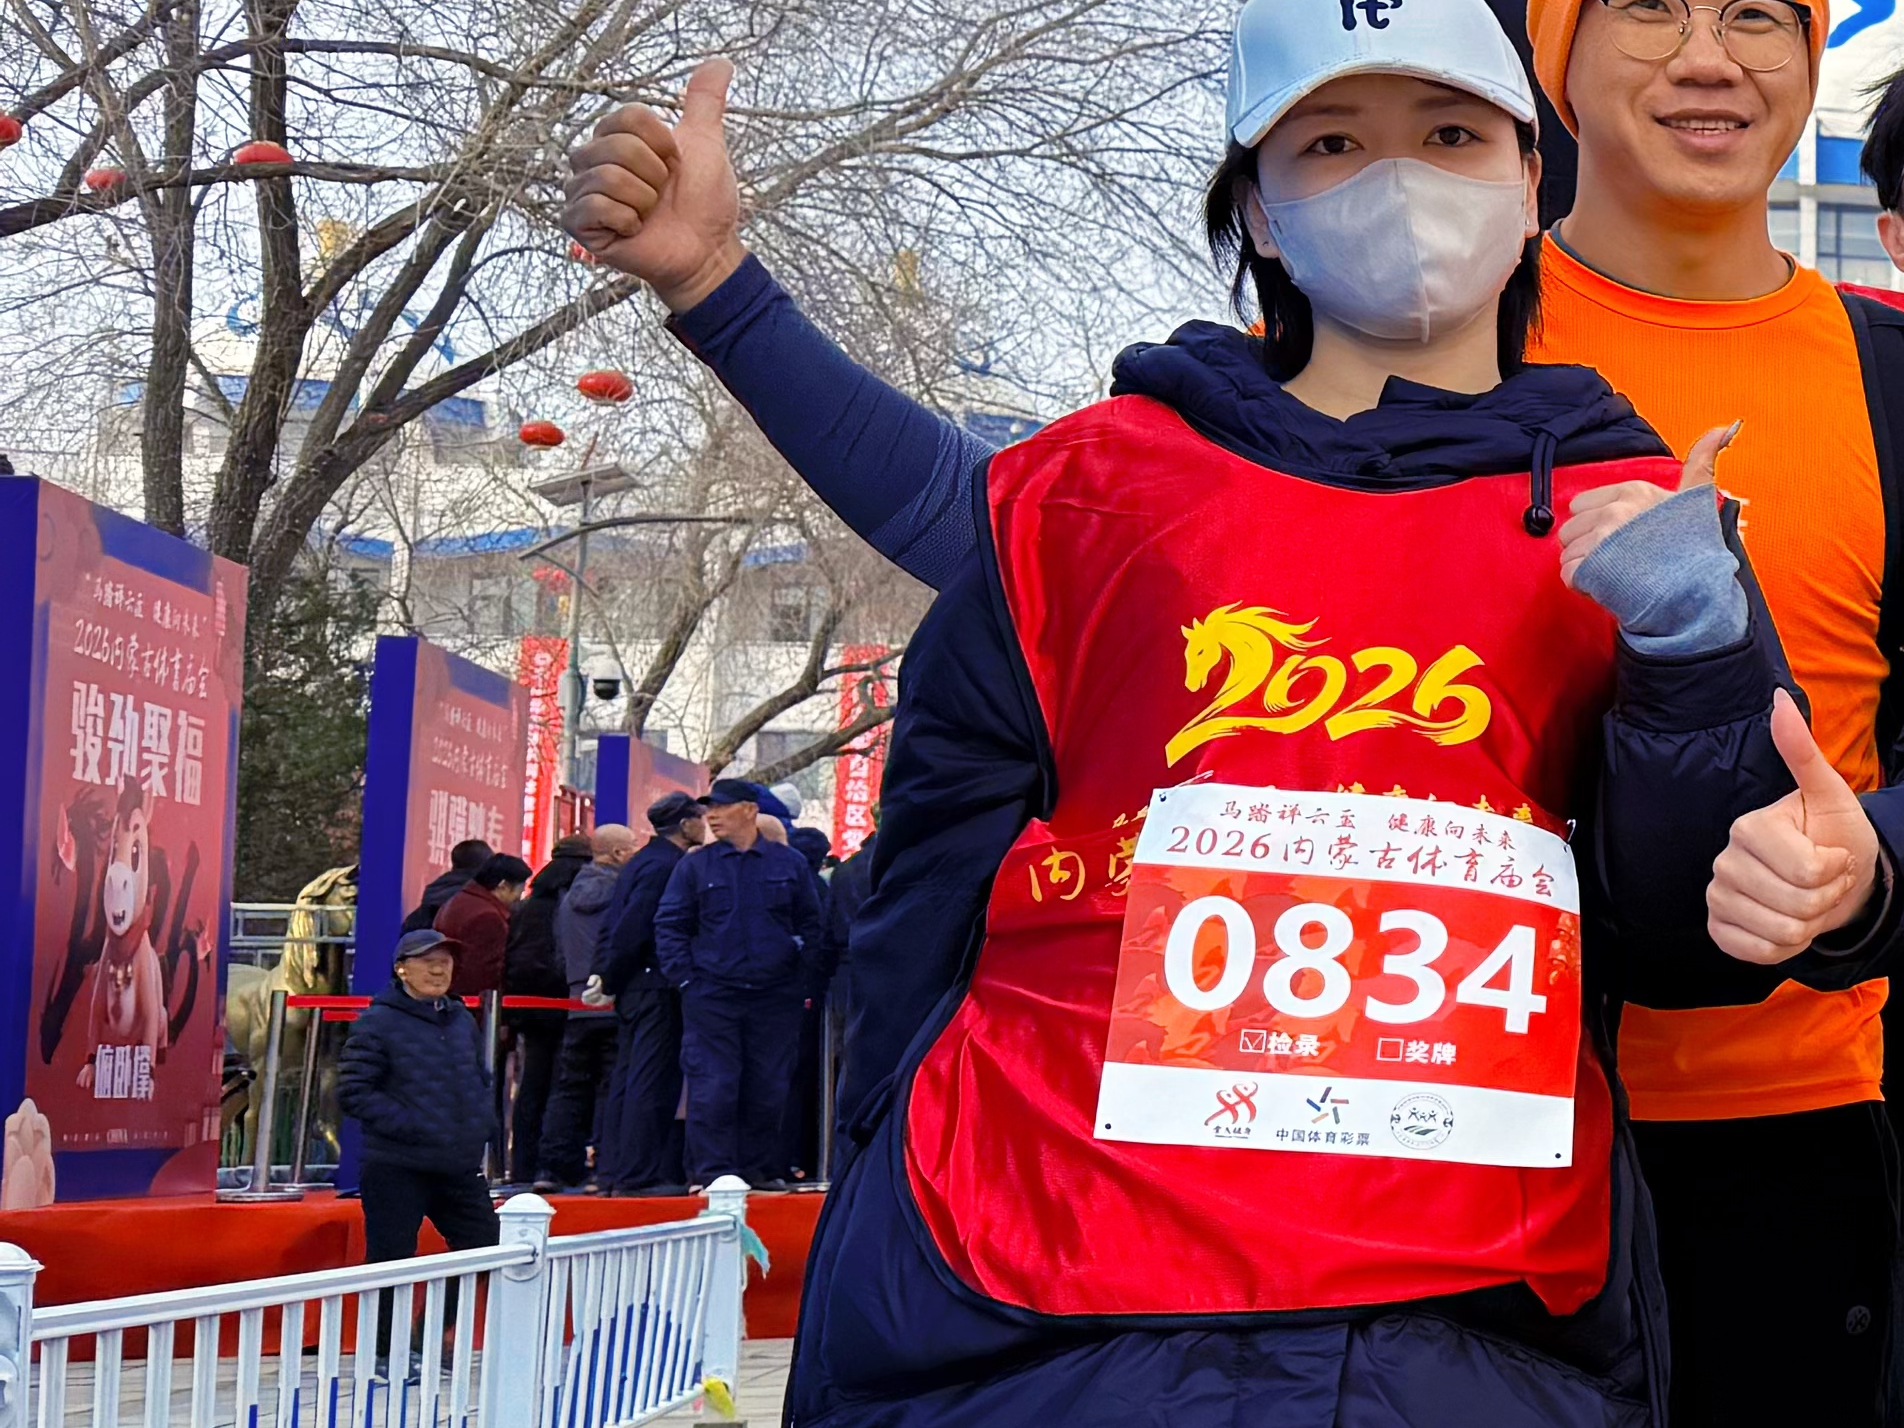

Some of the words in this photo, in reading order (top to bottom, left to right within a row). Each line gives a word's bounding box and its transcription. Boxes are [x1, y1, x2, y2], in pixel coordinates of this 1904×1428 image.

[1165, 600, 1492, 768] 2026
[1218, 800, 1357, 830] 马踏祥云至
[1387, 813, 1518, 852] 健康向未来
[1163, 895, 1547, 1034] 0834
[1267, 1031, 1321, 1057] 检录
[1404, 1040, 1458, 1066] 奖牌
[1276, 1128, 1371, 1146] 中国体育彩票
